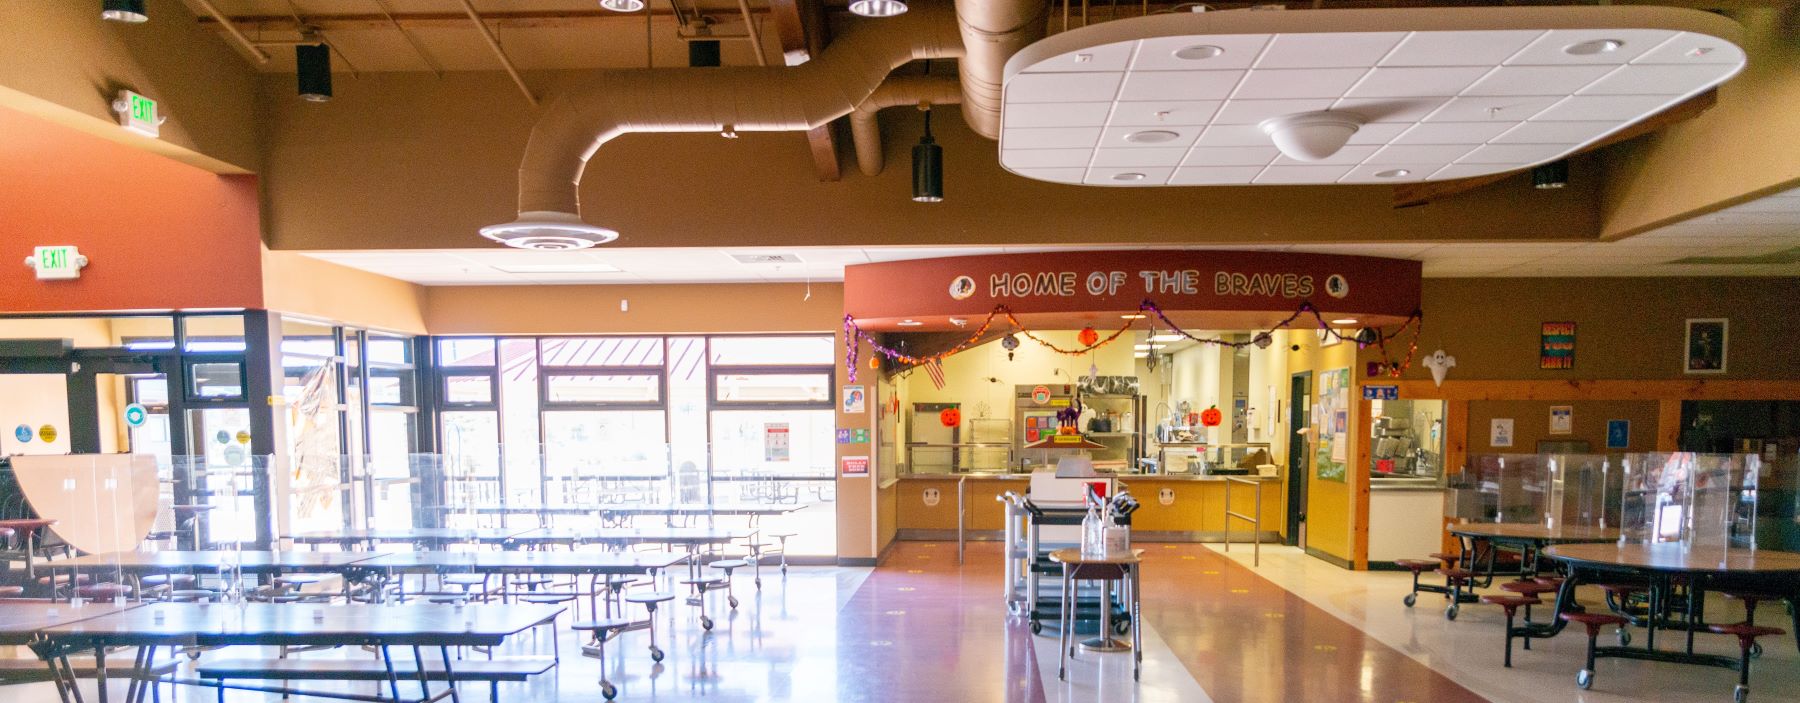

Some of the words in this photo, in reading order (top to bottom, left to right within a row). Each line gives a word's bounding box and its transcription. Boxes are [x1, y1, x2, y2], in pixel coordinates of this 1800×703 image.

[132, 95, 153, 123] EXIT
[42, 249, 67, 269] EXIT
[990, 272, 1077, 298] HOME
[1086, 271, 1127, 296] OF
[1139, 270, 1200, 294] THE
[1215, 271, 1314, 298] BRAVES
